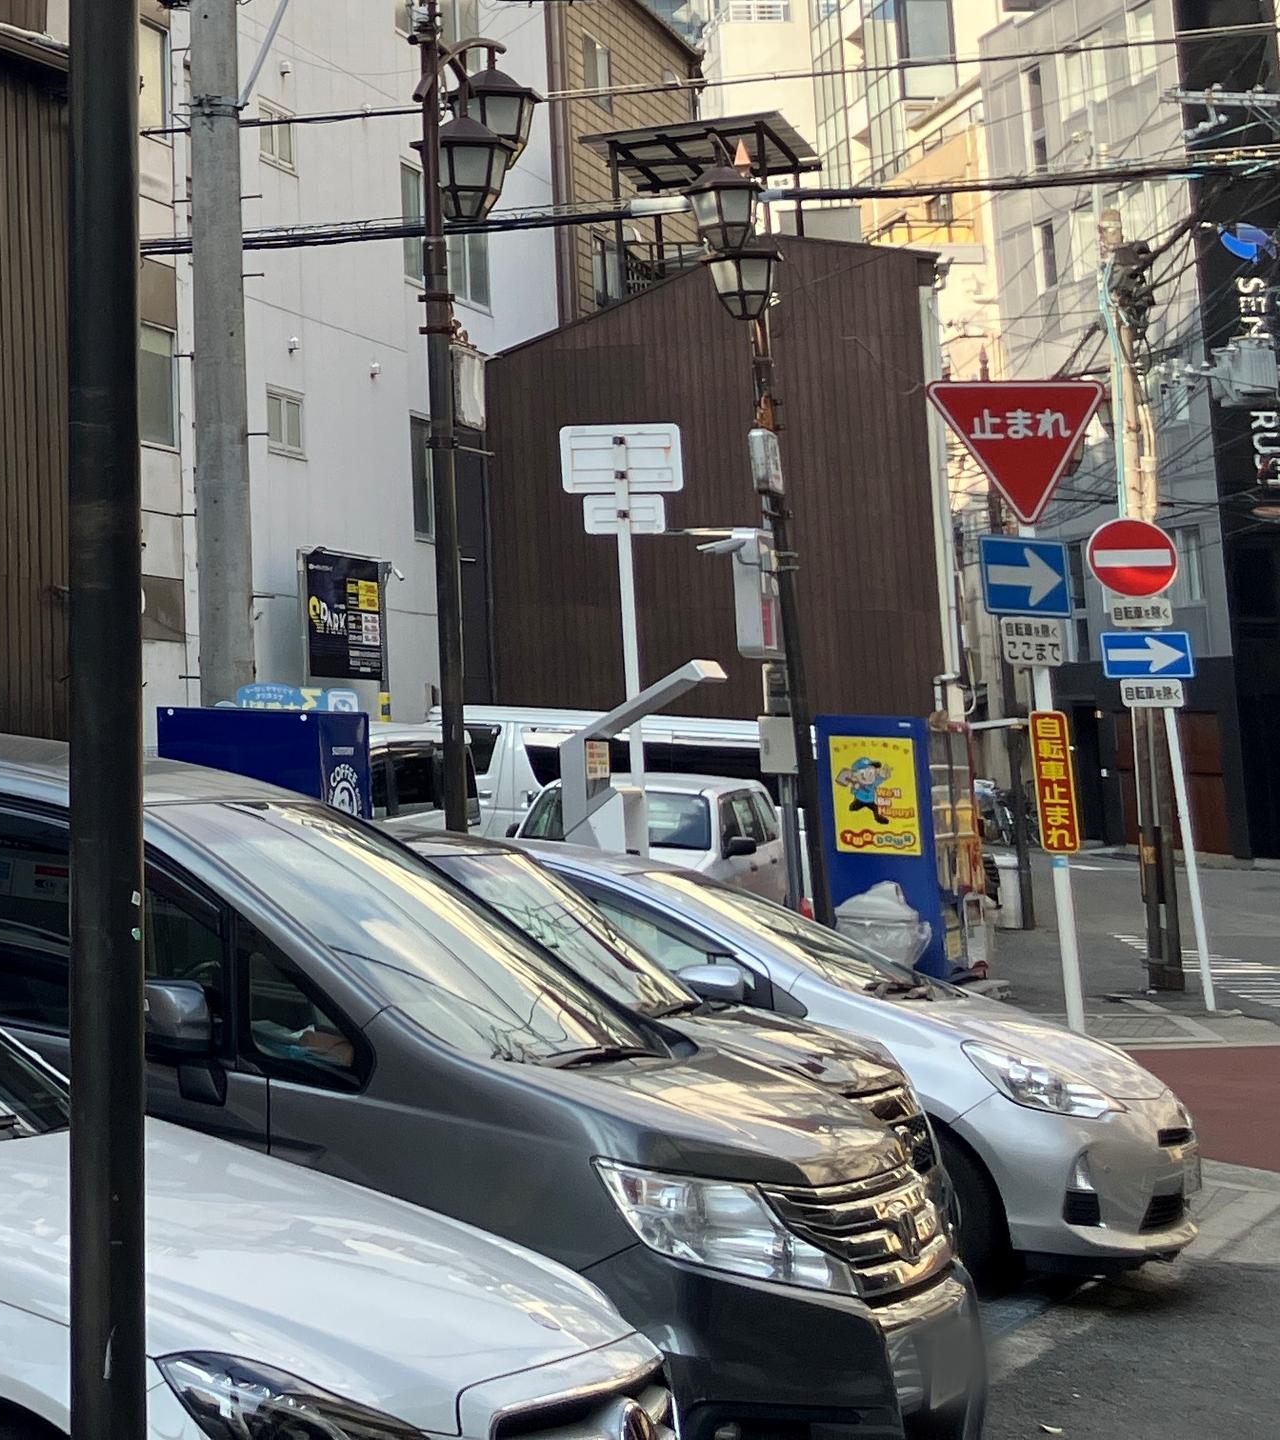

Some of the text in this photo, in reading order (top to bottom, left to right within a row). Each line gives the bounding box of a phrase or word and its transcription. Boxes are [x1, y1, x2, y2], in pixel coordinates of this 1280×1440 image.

[970, 409, 1071, 440] 止まれ
[1007, 641, 1061, 662] ここまで
[330, 764, 358, 788] COFFEE
[1036, 717, 1074, 848] 自転車止まれ
